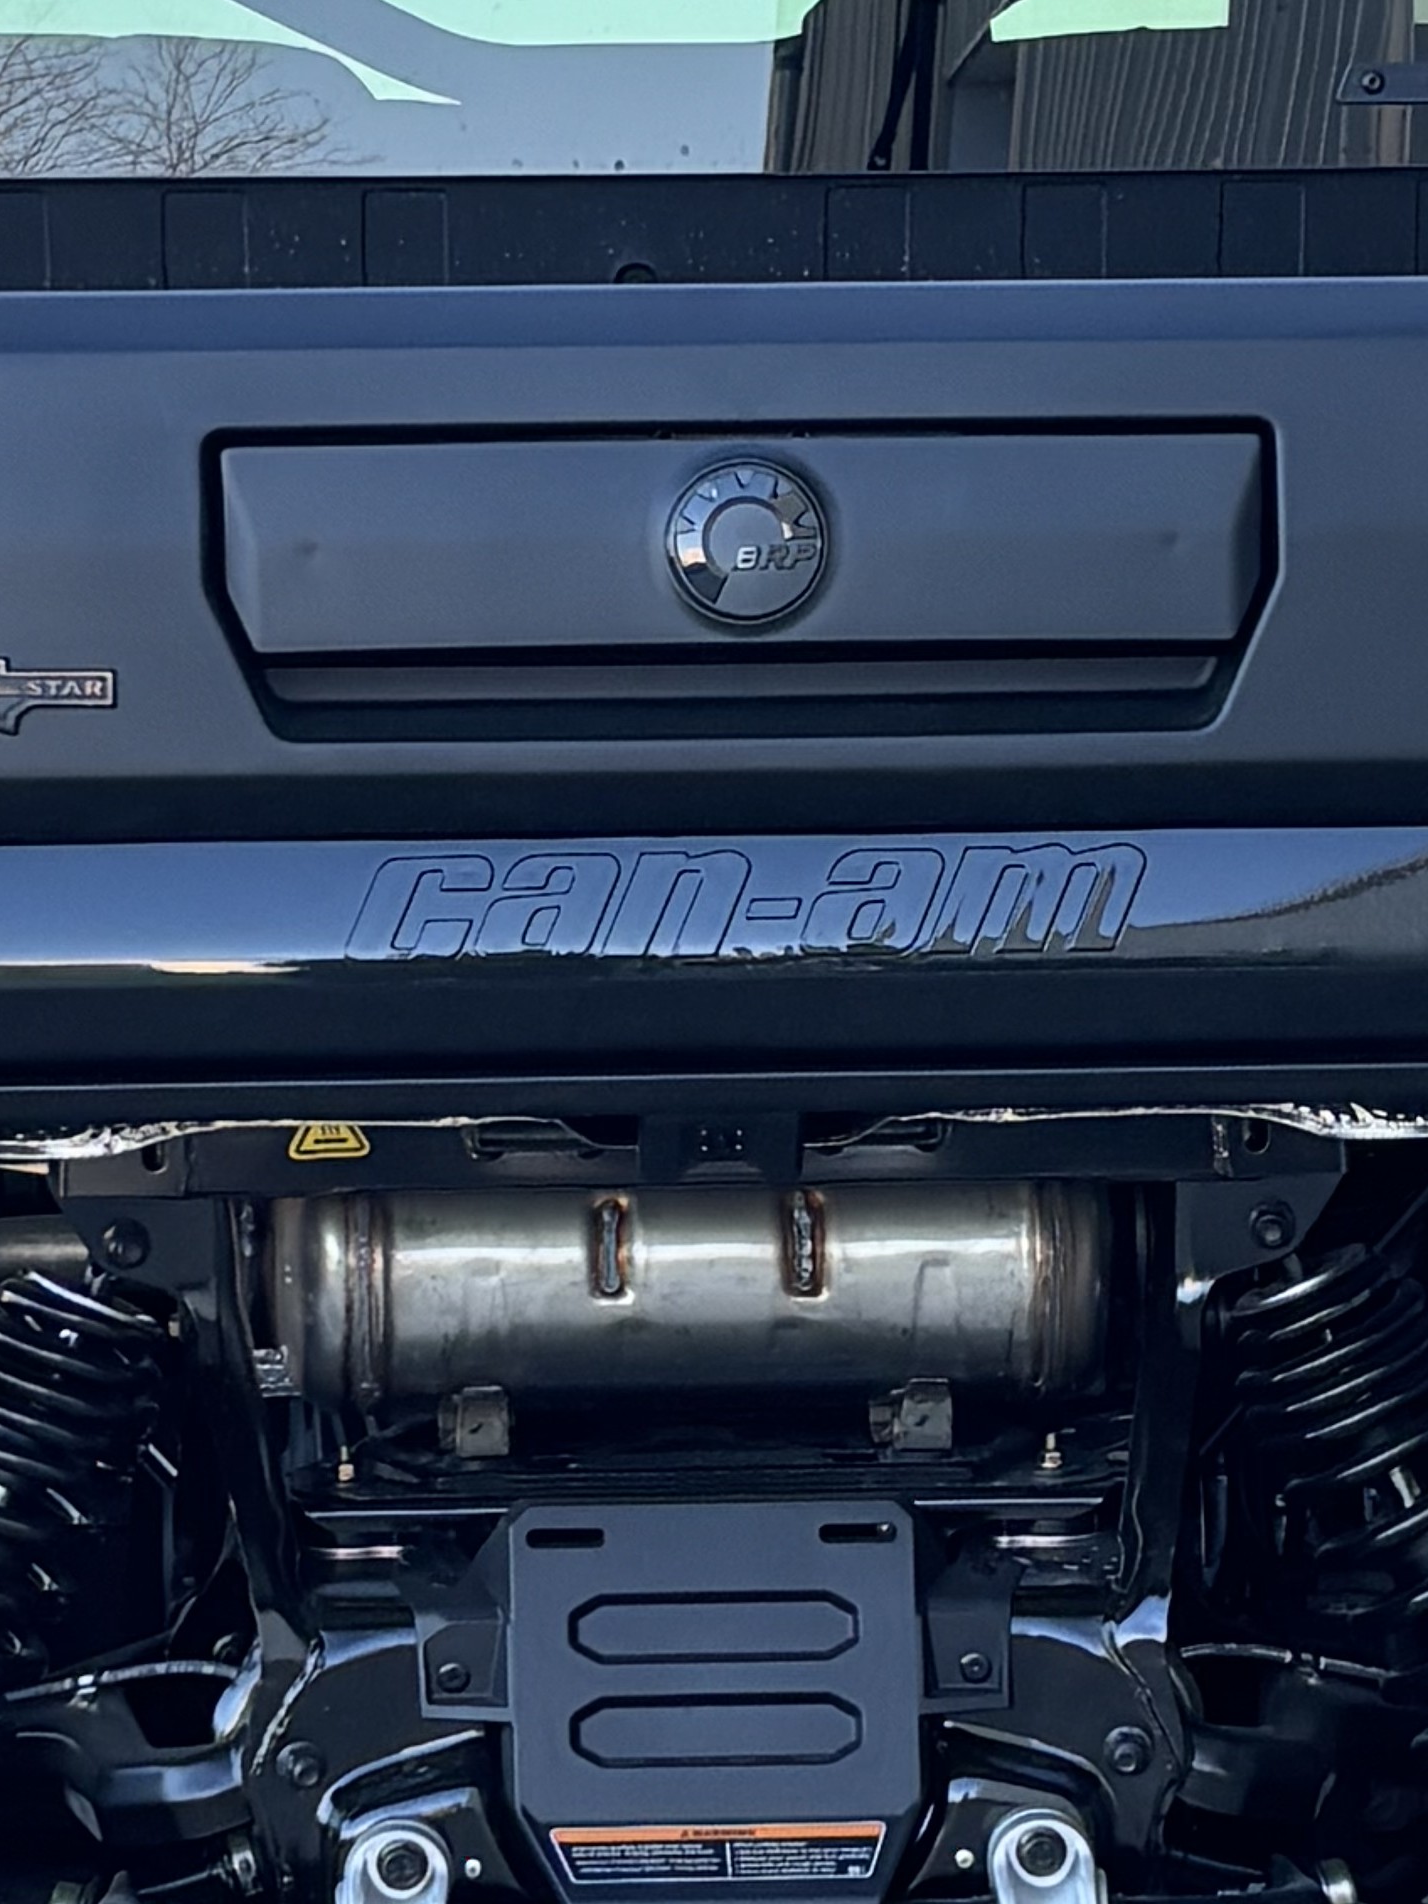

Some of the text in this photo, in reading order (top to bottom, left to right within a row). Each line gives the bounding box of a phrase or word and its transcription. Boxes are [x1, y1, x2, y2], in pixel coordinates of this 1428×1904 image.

[734, 543, 818, 571] BRP
[25, 679, 104, 696] STAR
[344, 842, 1148, 960] can-am
